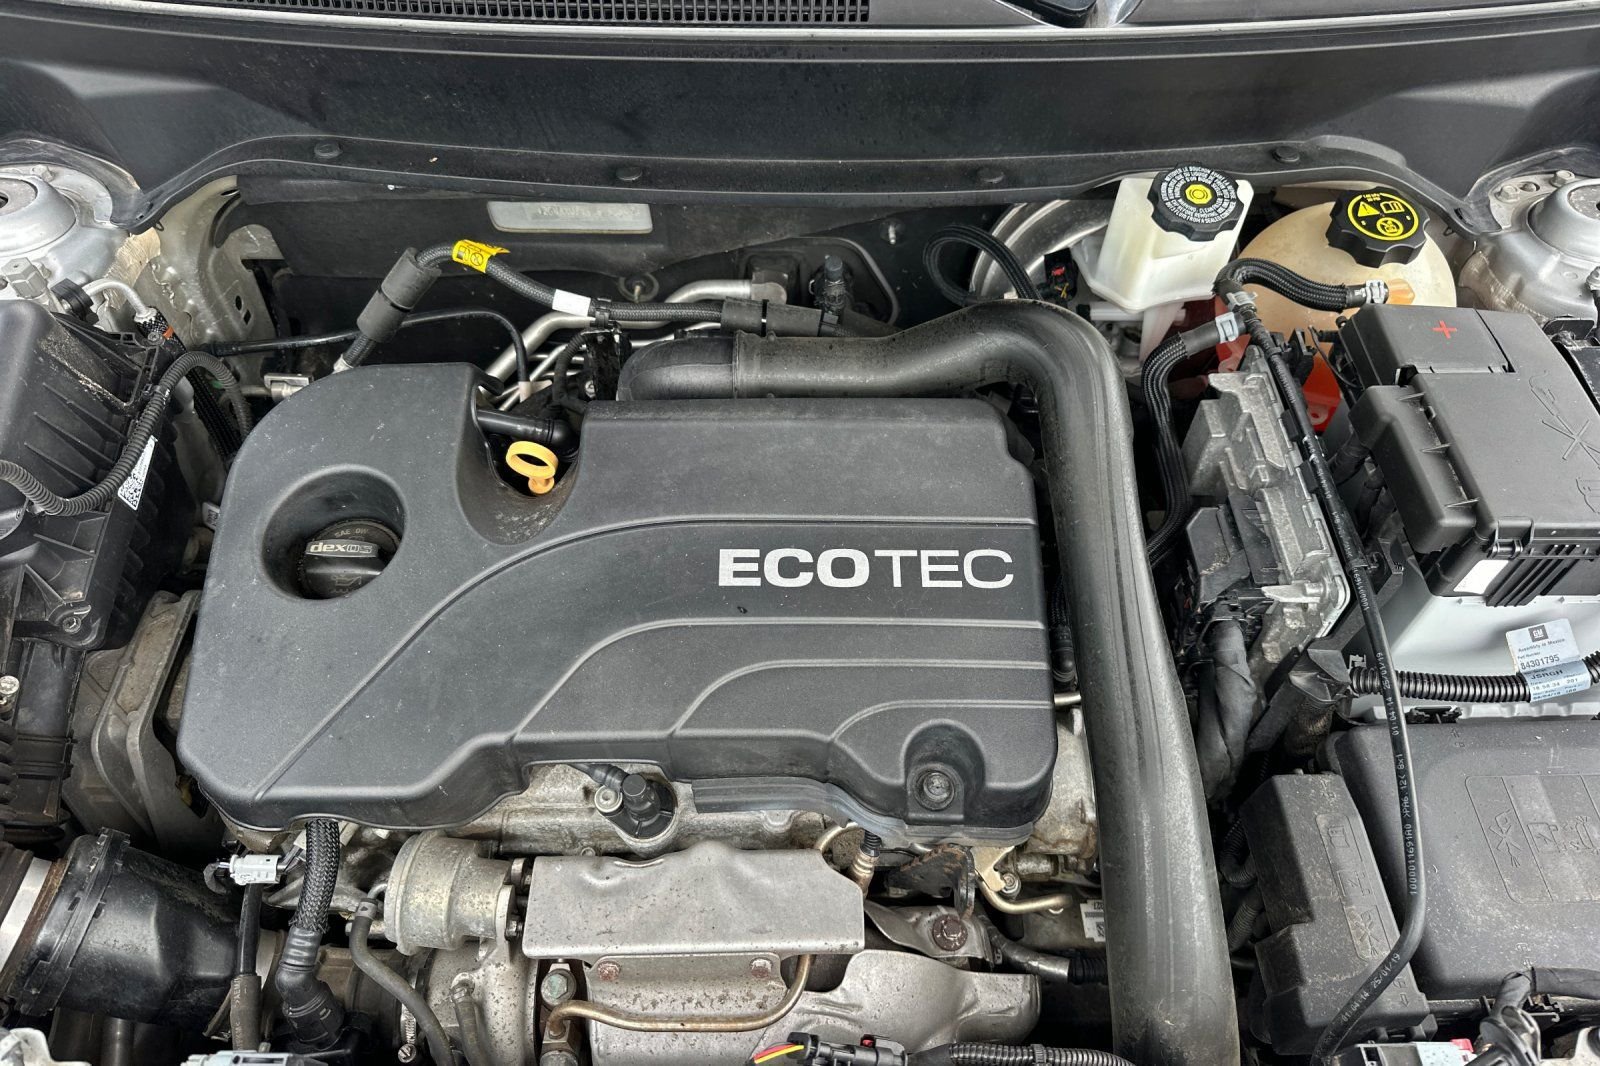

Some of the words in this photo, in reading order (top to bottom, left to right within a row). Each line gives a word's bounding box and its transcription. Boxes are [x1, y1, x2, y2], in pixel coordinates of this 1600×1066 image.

[334, 528, 351, 538] SAE
[310, 542, 373, 554] dexos
[718, 548, 1014, 589] ECOTEC
[1376, 652, 1391, 690] 25/01/19
[1520, 654, 1560, 670] 84301795
[1370, 953, 1400, 988] 25/01/19
